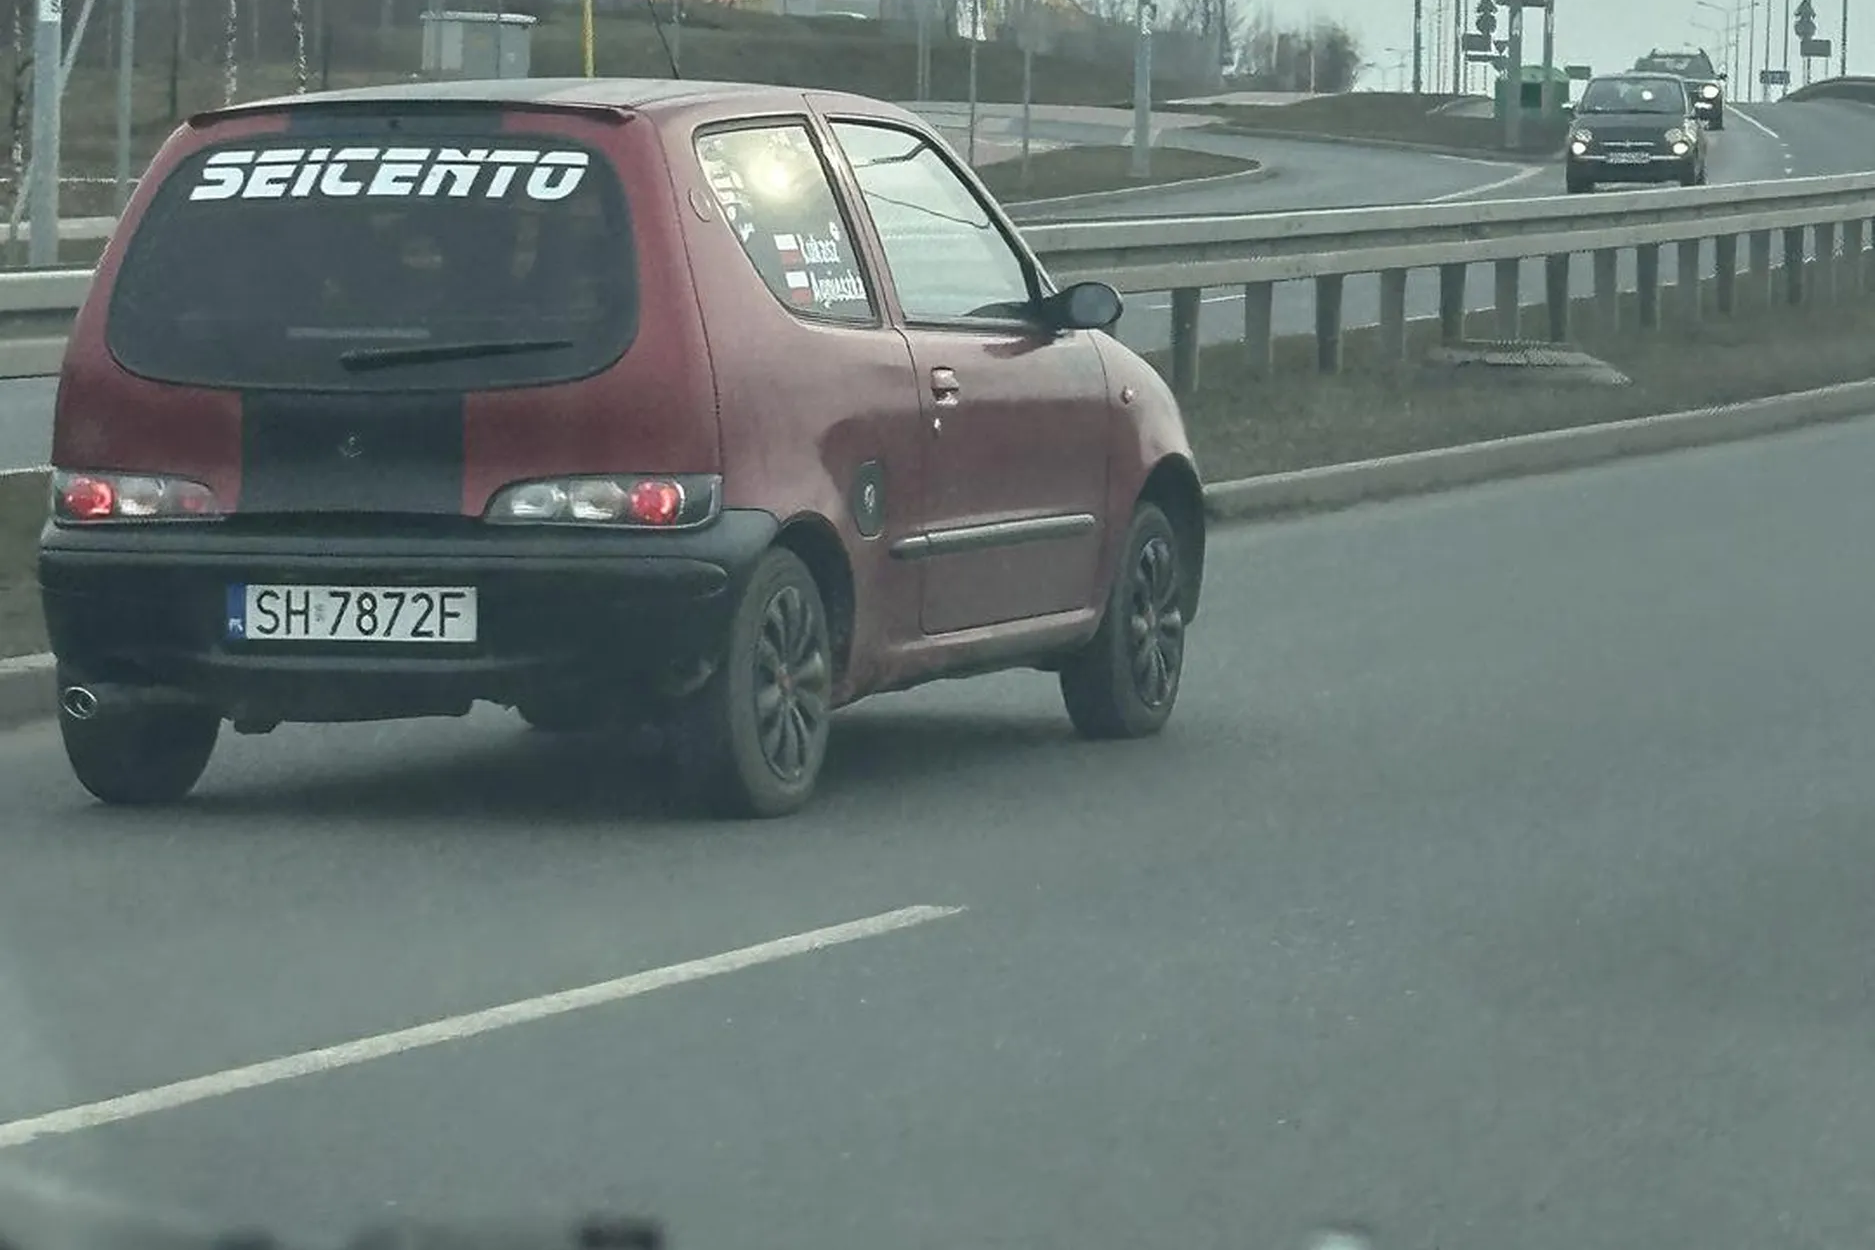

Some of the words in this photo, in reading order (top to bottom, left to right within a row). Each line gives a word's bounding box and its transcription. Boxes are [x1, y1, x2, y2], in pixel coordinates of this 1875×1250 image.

[189, 148, 590, 201] SEICENTO
[256, 589, 310, 635] SH
[329, 591, 466, 638] 7872F
